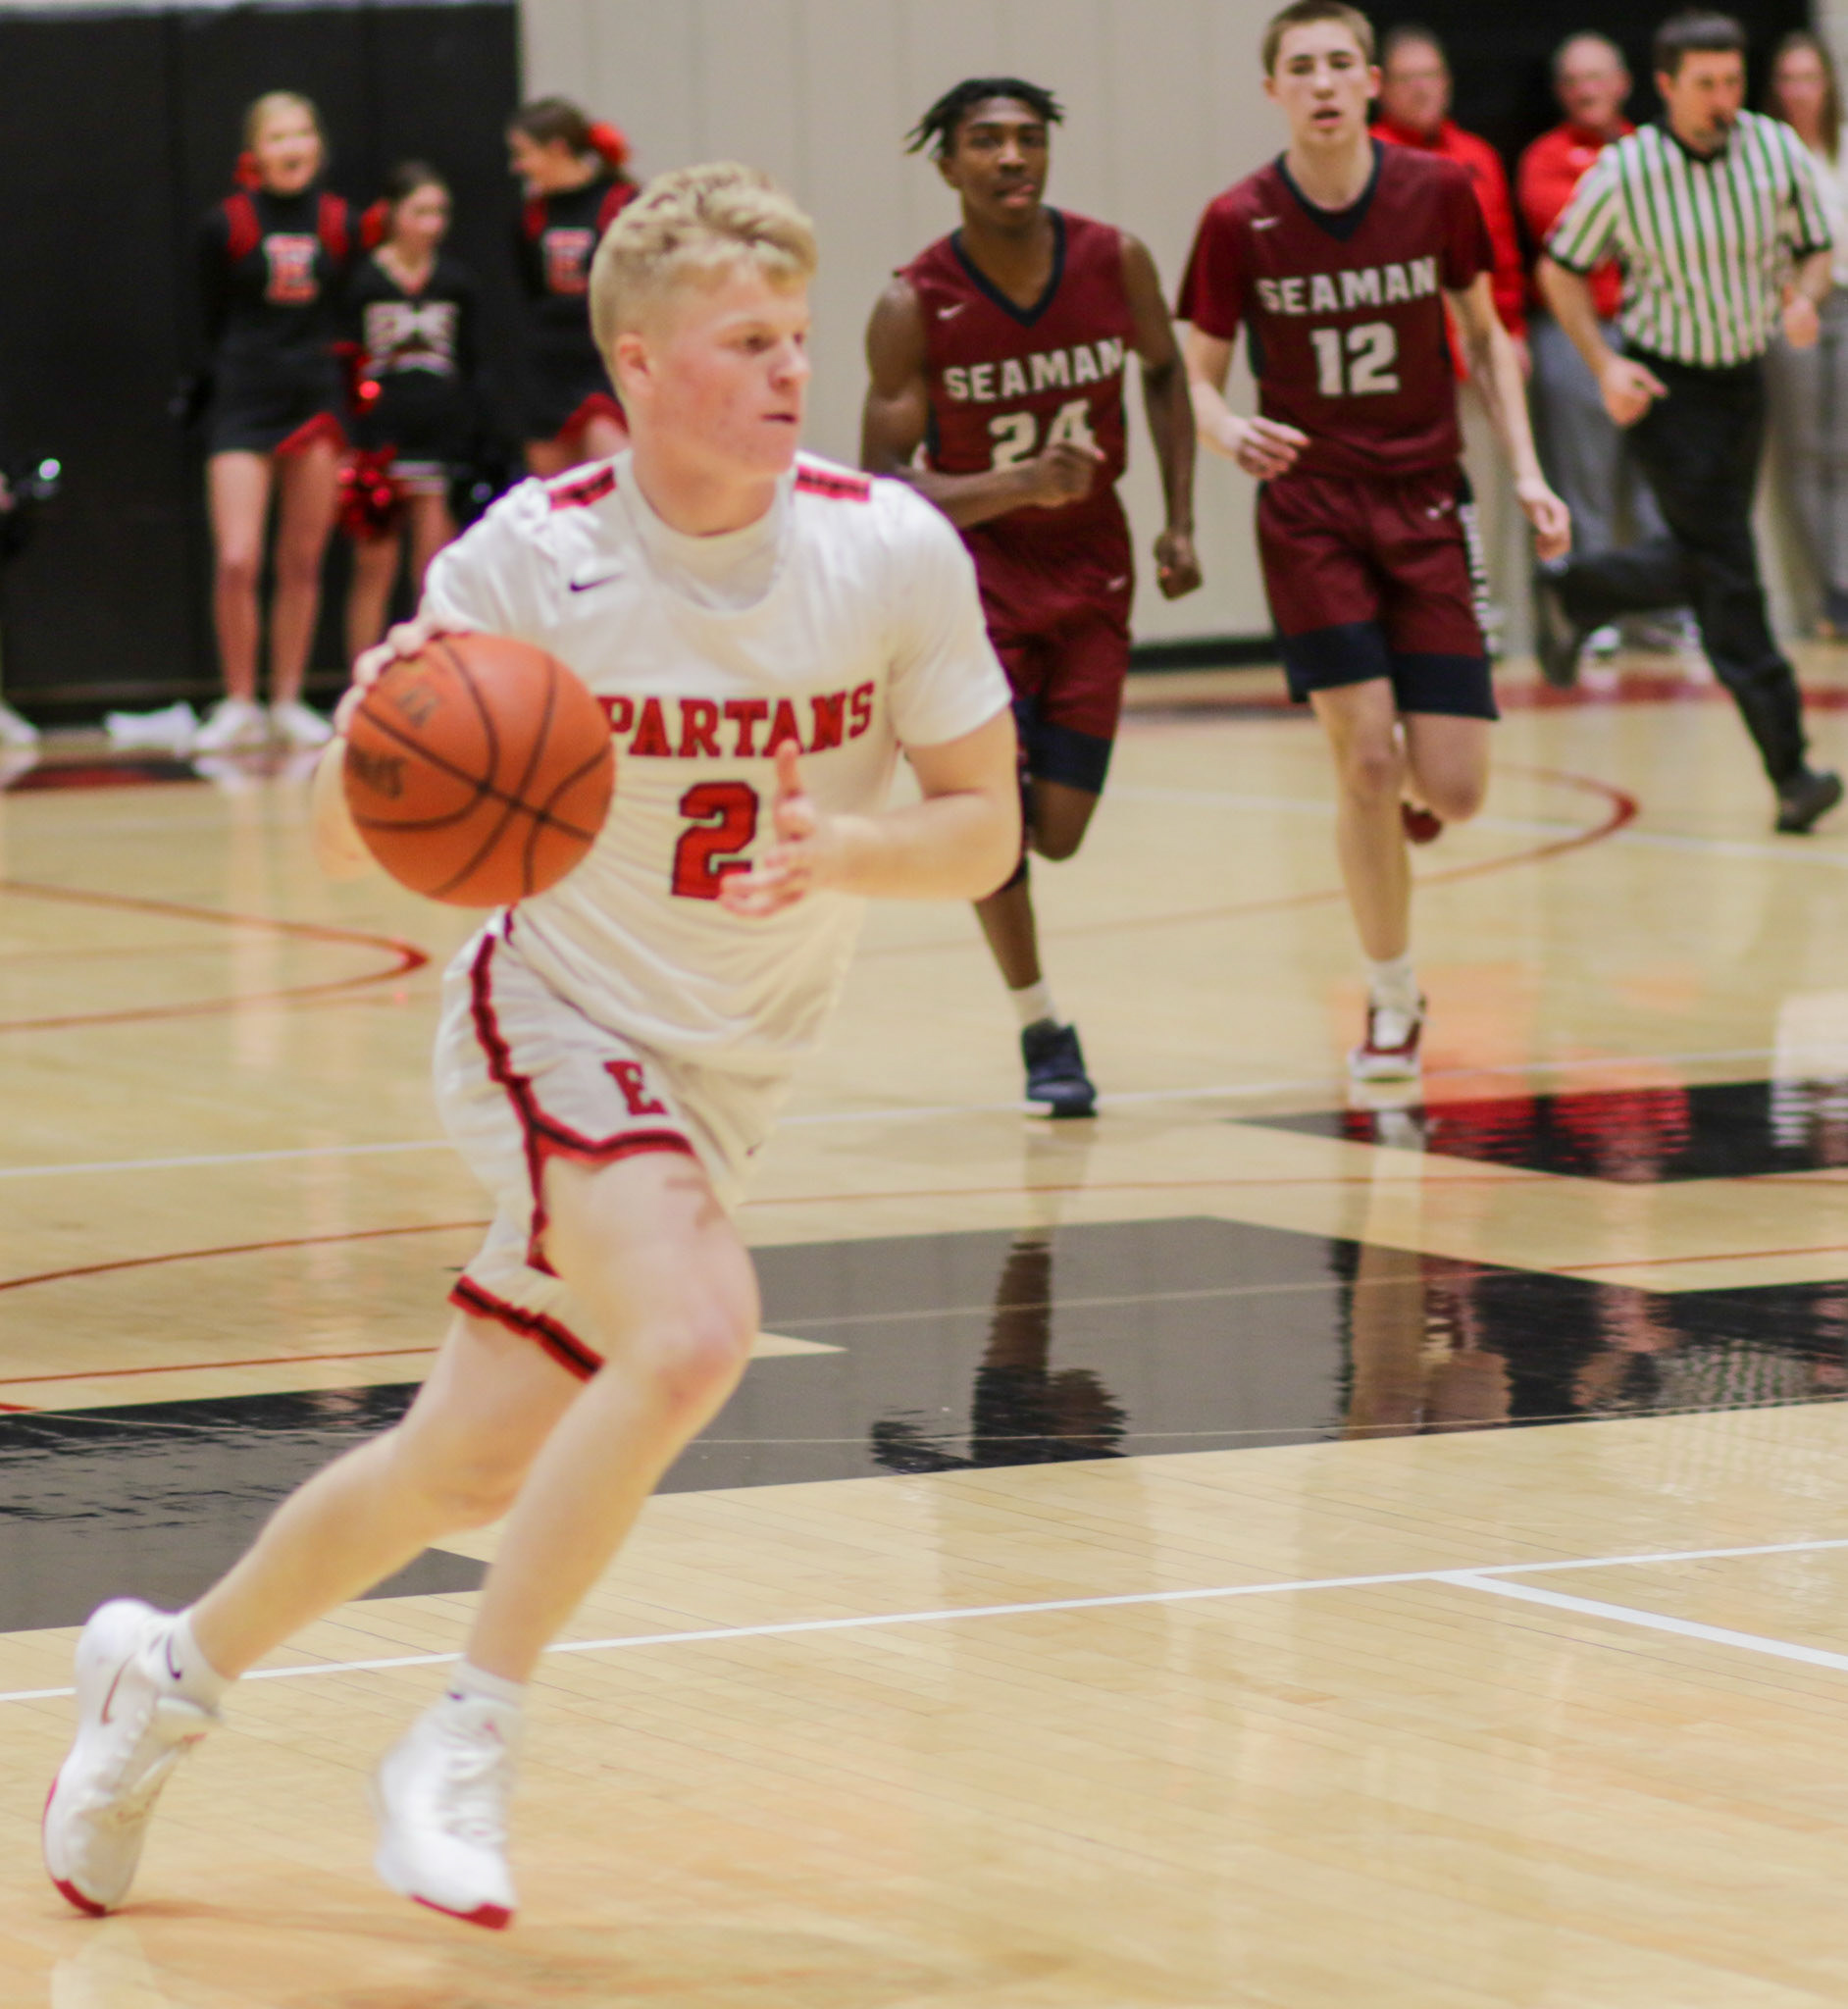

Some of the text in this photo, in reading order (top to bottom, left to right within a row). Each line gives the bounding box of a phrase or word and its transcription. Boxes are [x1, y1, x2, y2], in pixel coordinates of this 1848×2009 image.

[1256, 255, 1437, 315] SEAMAN
[943, 336, 1123, 401] SEAMAN
[1310, 321, 1400, 395] 12
[989, 398, 1098, 471] 24
[594, 680, 876, 757] PARTANS
[670, 781, 759, 901] 2
[602, 1059, 670, 1116] E
